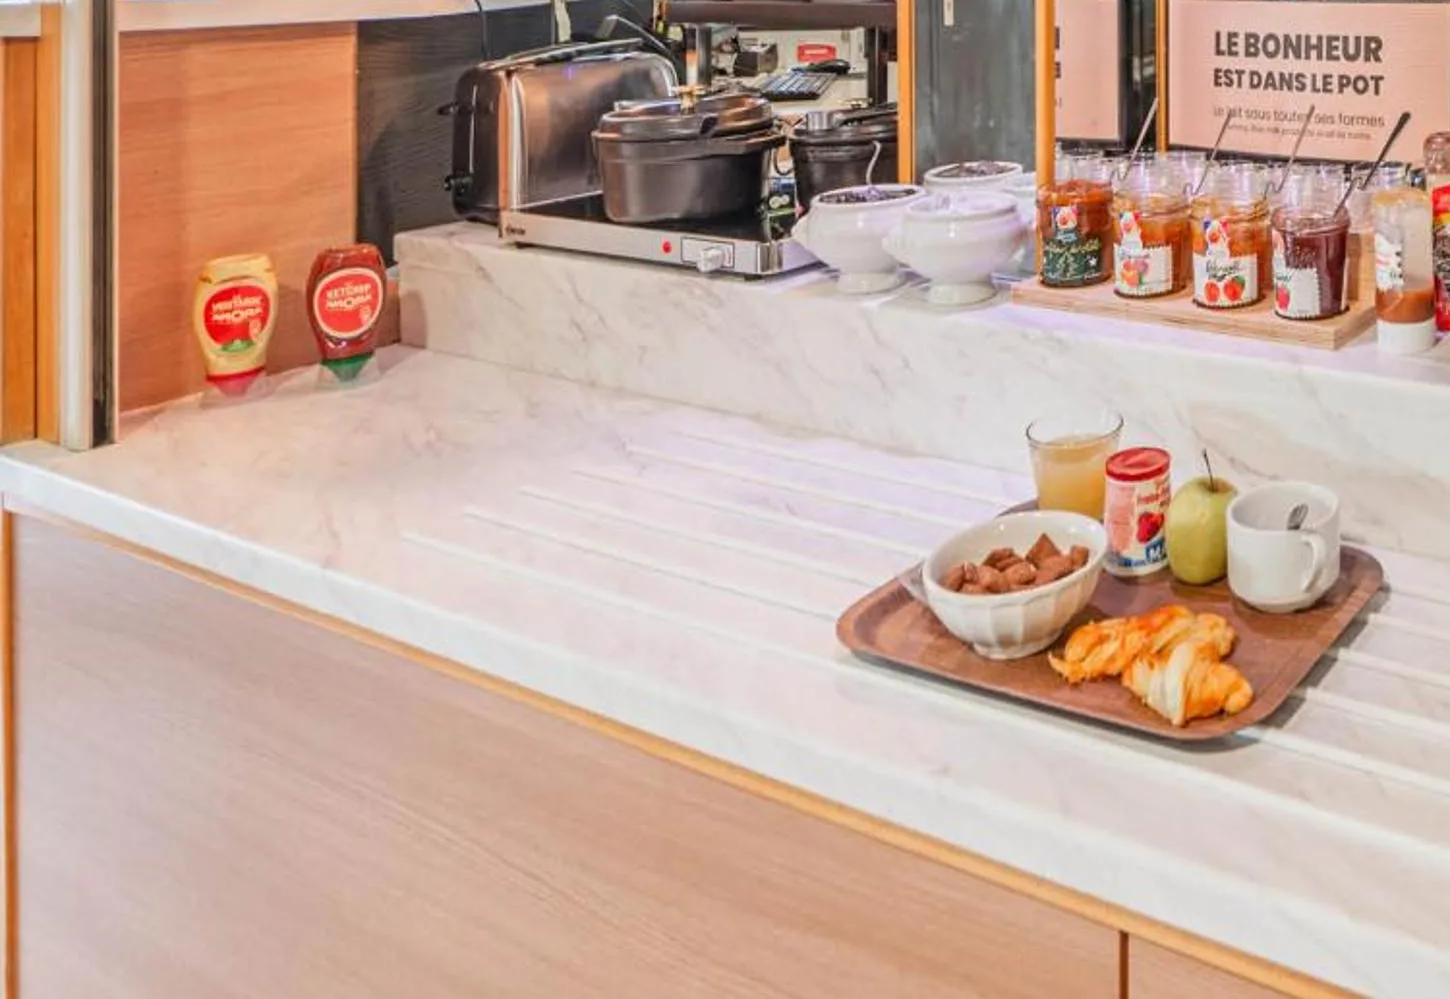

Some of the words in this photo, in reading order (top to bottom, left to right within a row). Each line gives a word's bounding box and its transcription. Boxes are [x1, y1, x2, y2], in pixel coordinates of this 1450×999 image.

[1214, 31, 1239, 57] LE
[1244, 32, 1384, 63] BONHEUR
[1213, 68, 1246, 89] EST
[1249, 70, 1308, 93] DANS
[1311, 73, 1334, 94] LE
[1338, 74, 1385, 96] POT
[1338, 112, 1386, 128] formes
